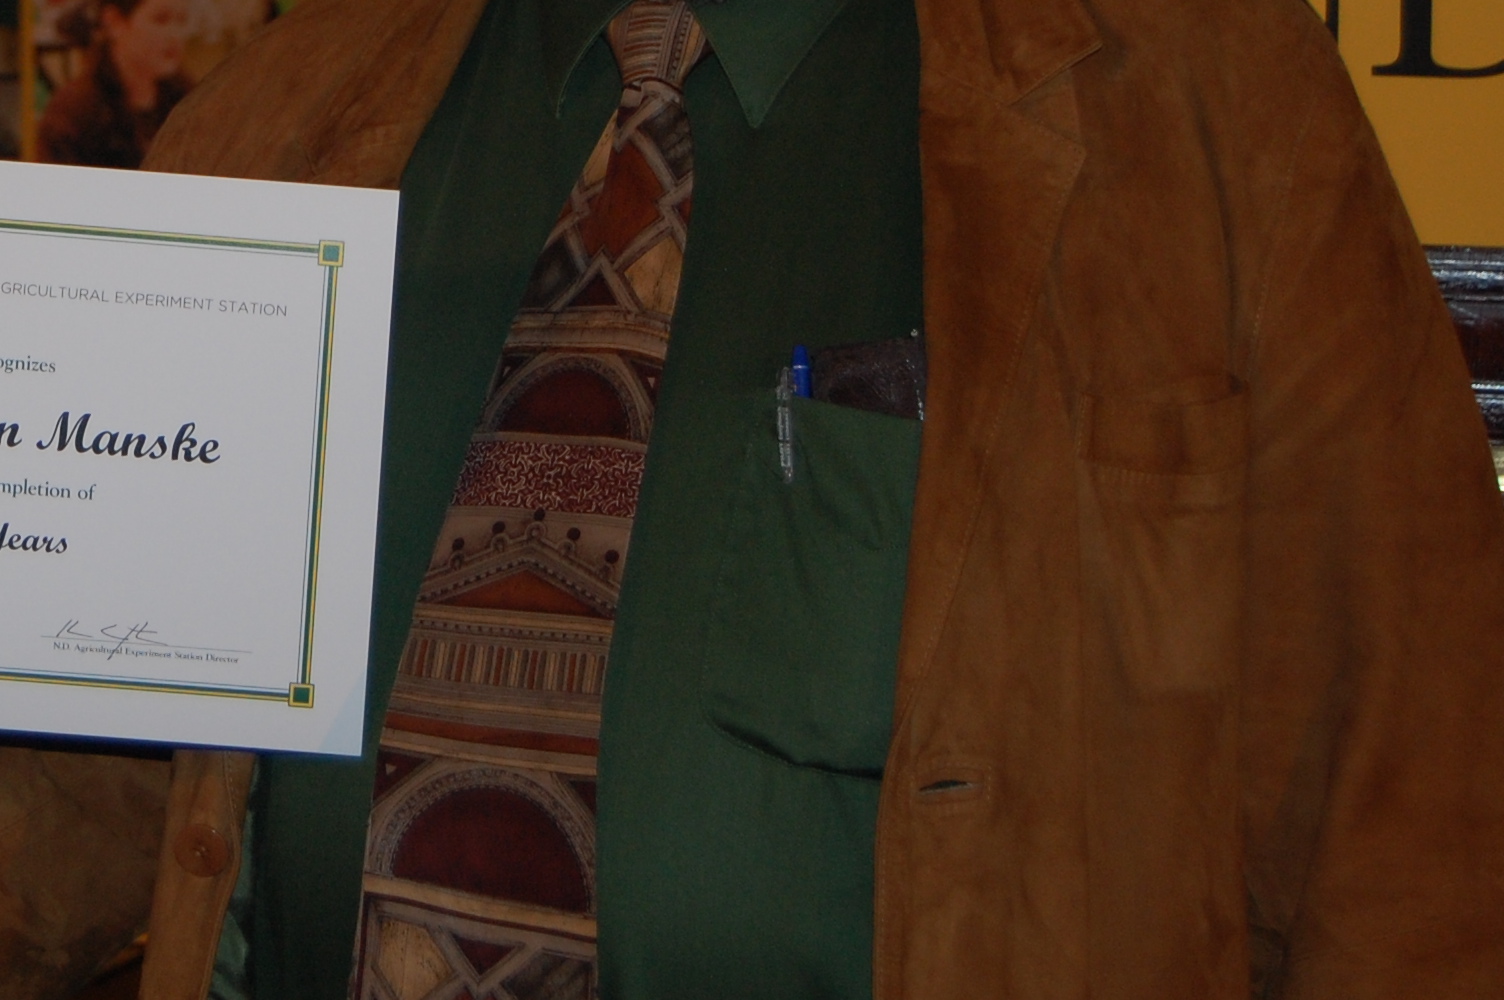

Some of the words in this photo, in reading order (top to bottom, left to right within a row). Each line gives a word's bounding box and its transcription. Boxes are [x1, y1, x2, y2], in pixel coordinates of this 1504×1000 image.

[114, 291, 213, 311] EXPERIMENT
[218, 300, 288, 317] STATION
[36, 411, 221, 464] Manske
[77, 483, 98, 501] of
[174, 651, 203, 661] Station
[206, 653, 239, 664] Director
